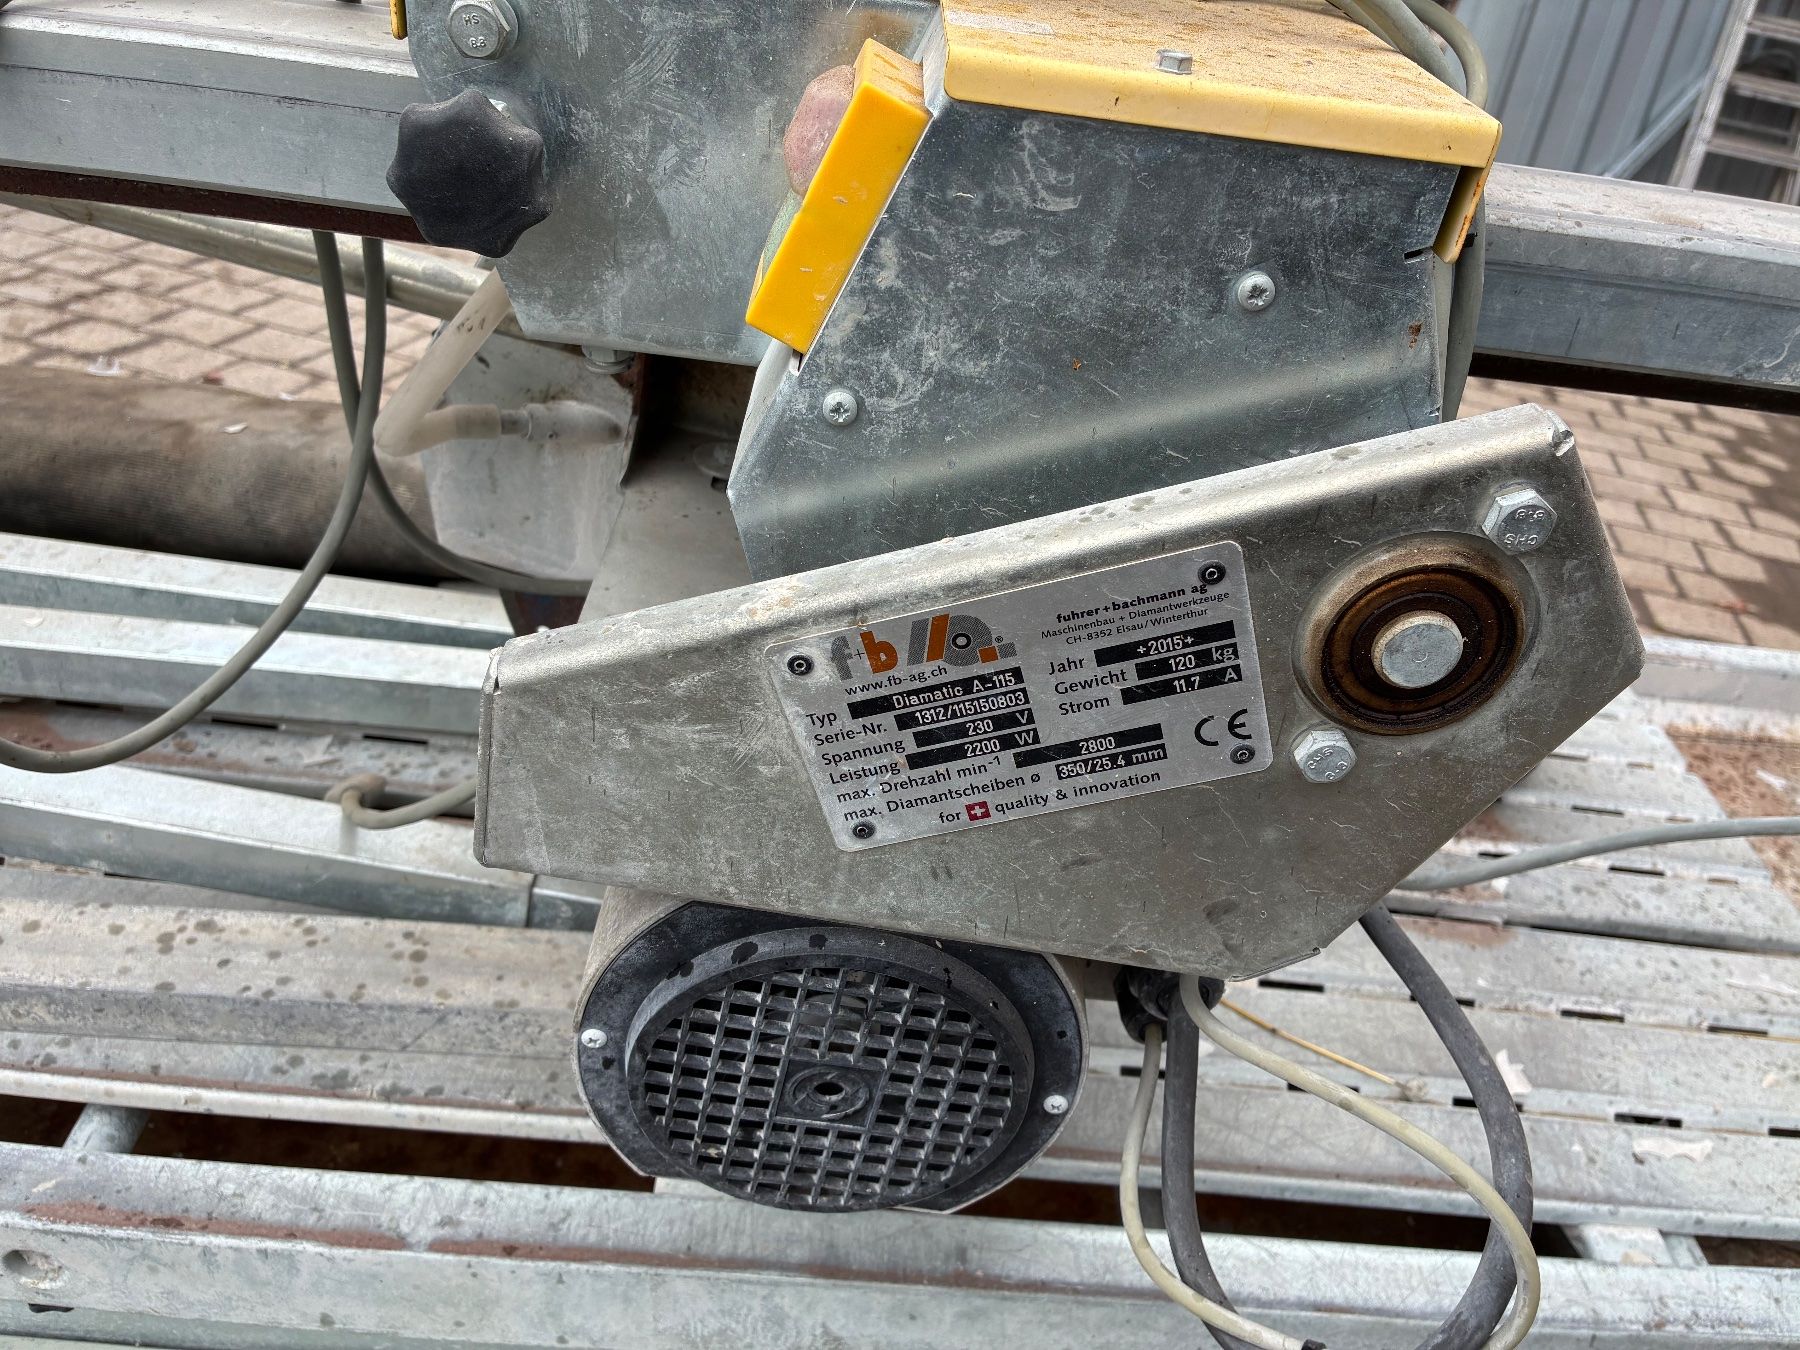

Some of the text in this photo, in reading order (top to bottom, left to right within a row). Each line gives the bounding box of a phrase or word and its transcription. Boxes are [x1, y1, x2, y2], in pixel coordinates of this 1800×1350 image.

[1190, 582, 1208, 595] ag
[1041, 617, 1116, 640] Maschinenbau
[1128, 592, 1230, 620] Diamantwerkzeuge
[1065, 628, 1113, 645] CH-8352
[844, 664, 948, 696] www.fb-ag.ch
[1048, 656, 1085, 676] Jahr
[1054, 647, 1236, 695] Gewicht 120 kg
[805, 672, 1016, 729] Typ Diamatic A-115
[1058, 667, 1239, 716] Strom 11.7 A
[813, 691, 1025, 747] Serie-Nr. 1312/115150803
[821, 710, 1029, 767] Spannung 230 V
[828, 730, 1034, 785] Leistung 2200 W
[836, 788, 876, 803] max.
[879, 767, 952, 794] Drehzahl
[1078, 736, 1116, 755] 2800
[843, 806, 882, 822] max.
[885, 776, 1026, 813] Diamantscheiben
[1058, 754, 1126, 778] 350/25.4
[1131, 748, 1164, 764] mm
[938, 772, 1161, 824] for quality & innovation
